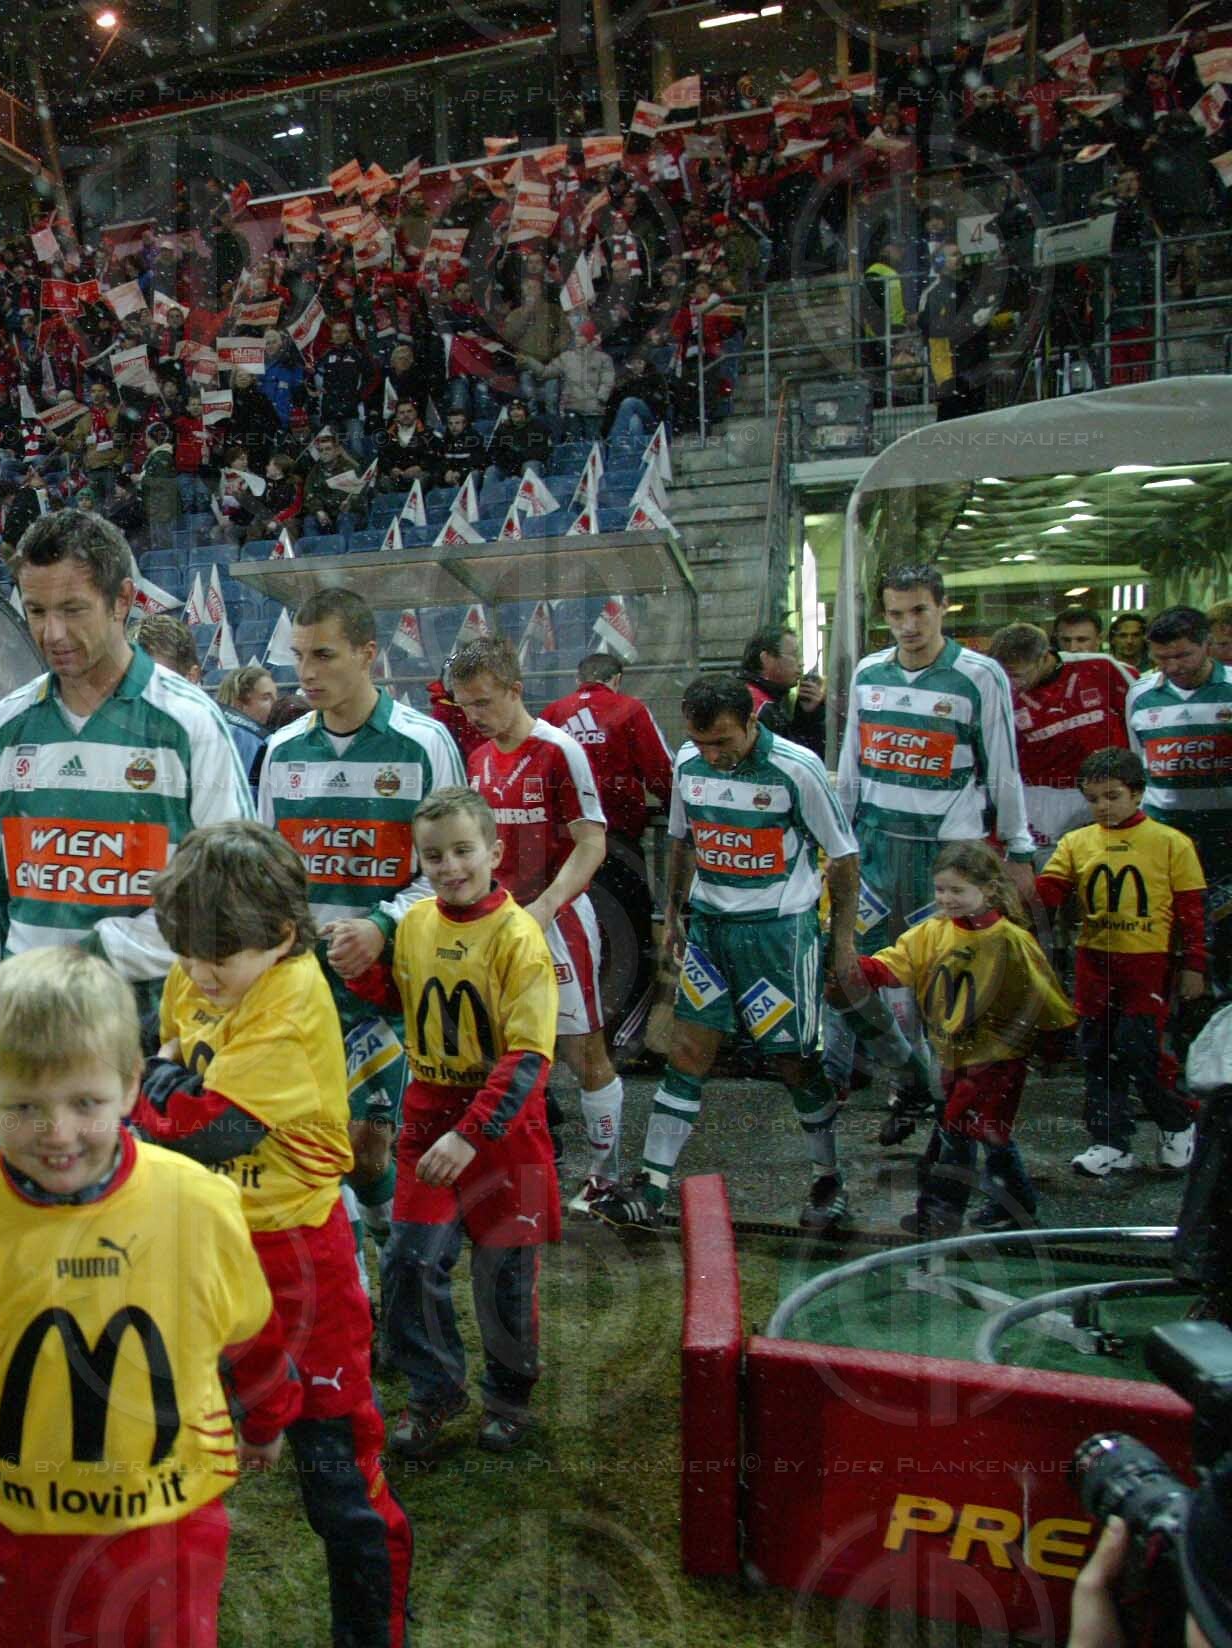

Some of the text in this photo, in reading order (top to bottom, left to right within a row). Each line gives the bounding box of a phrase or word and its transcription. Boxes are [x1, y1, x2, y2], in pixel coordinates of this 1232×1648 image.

[871, 730, 930, 749] WIEN
[1157, 740, 1217, 756] WIEN
[30, 828, 125, 860] WIEN
[301, 826, 376, 849] WIEN
[696, 828, 753, 849] WIEN
[301, 854, 401, 878] NERGIE
[15, 862, 162, 896] ENERGIE
[57, 1256, 120, 1279] PUMA
[159, 1469, 187, 1506] it
